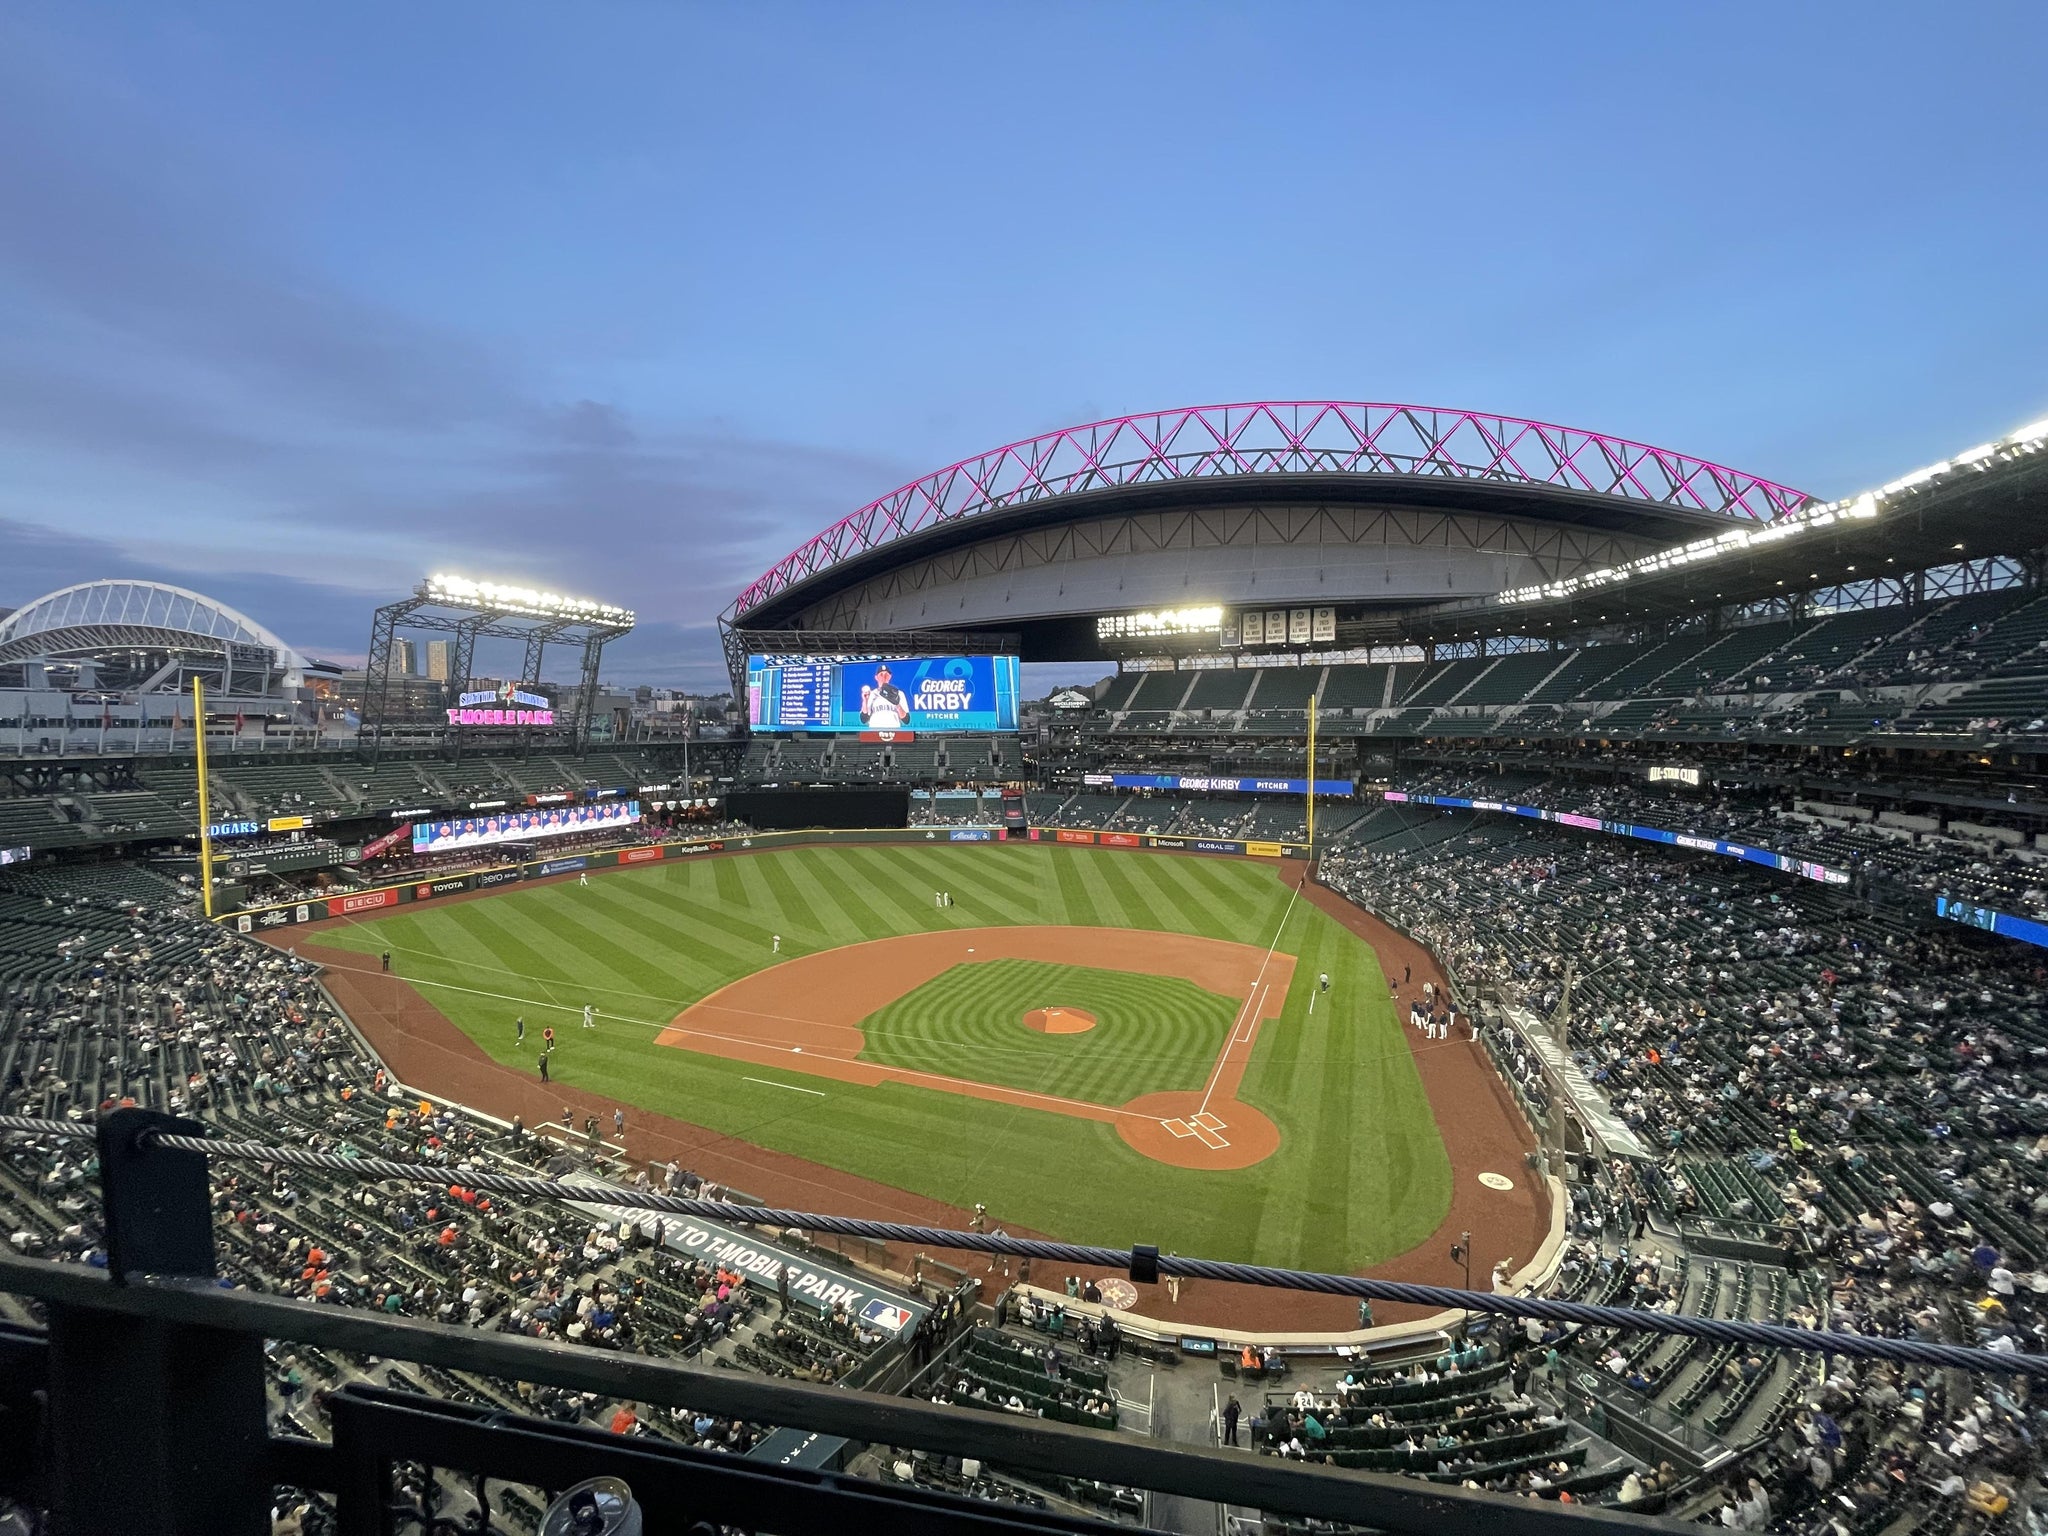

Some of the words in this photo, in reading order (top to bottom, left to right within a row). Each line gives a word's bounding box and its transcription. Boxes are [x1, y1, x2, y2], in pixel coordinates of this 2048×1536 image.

[920, 679, 966, 693] GEORGE
[913, 693, 972, 710] KIRBY
[446, 709, 516, 725] T-MOBILE
[517, 710, 553, 725] PARK
[1179, 777, 1209, 789] GEORGE
[1210, 779, 1241, 790] KIRBY
[1256, 781, 1289, 790] PITCHER
[681, 844, 710, 854] KeyBank
[1158, 839, 1184, 848] Microsoft
[1198, 842, 1224, 850] GLOBAL
[1676, 835, 1696, 848] GEORGE
[1696, 839, 1717, 851] KIRBY
[236, 850, 264, 859] HOME
[284, 844, 315, 853] PORCH
[433, 881, 464, 892] TOYOTA
[347, 895, 383, 908] BECU
[595, 1202, 684, 1237] ELCOME
[676, 1226, 709, 1247] TO
[703, 1236, 803, 1284] T-MOBILE
[793, 1272, 864, 1311] PARK
